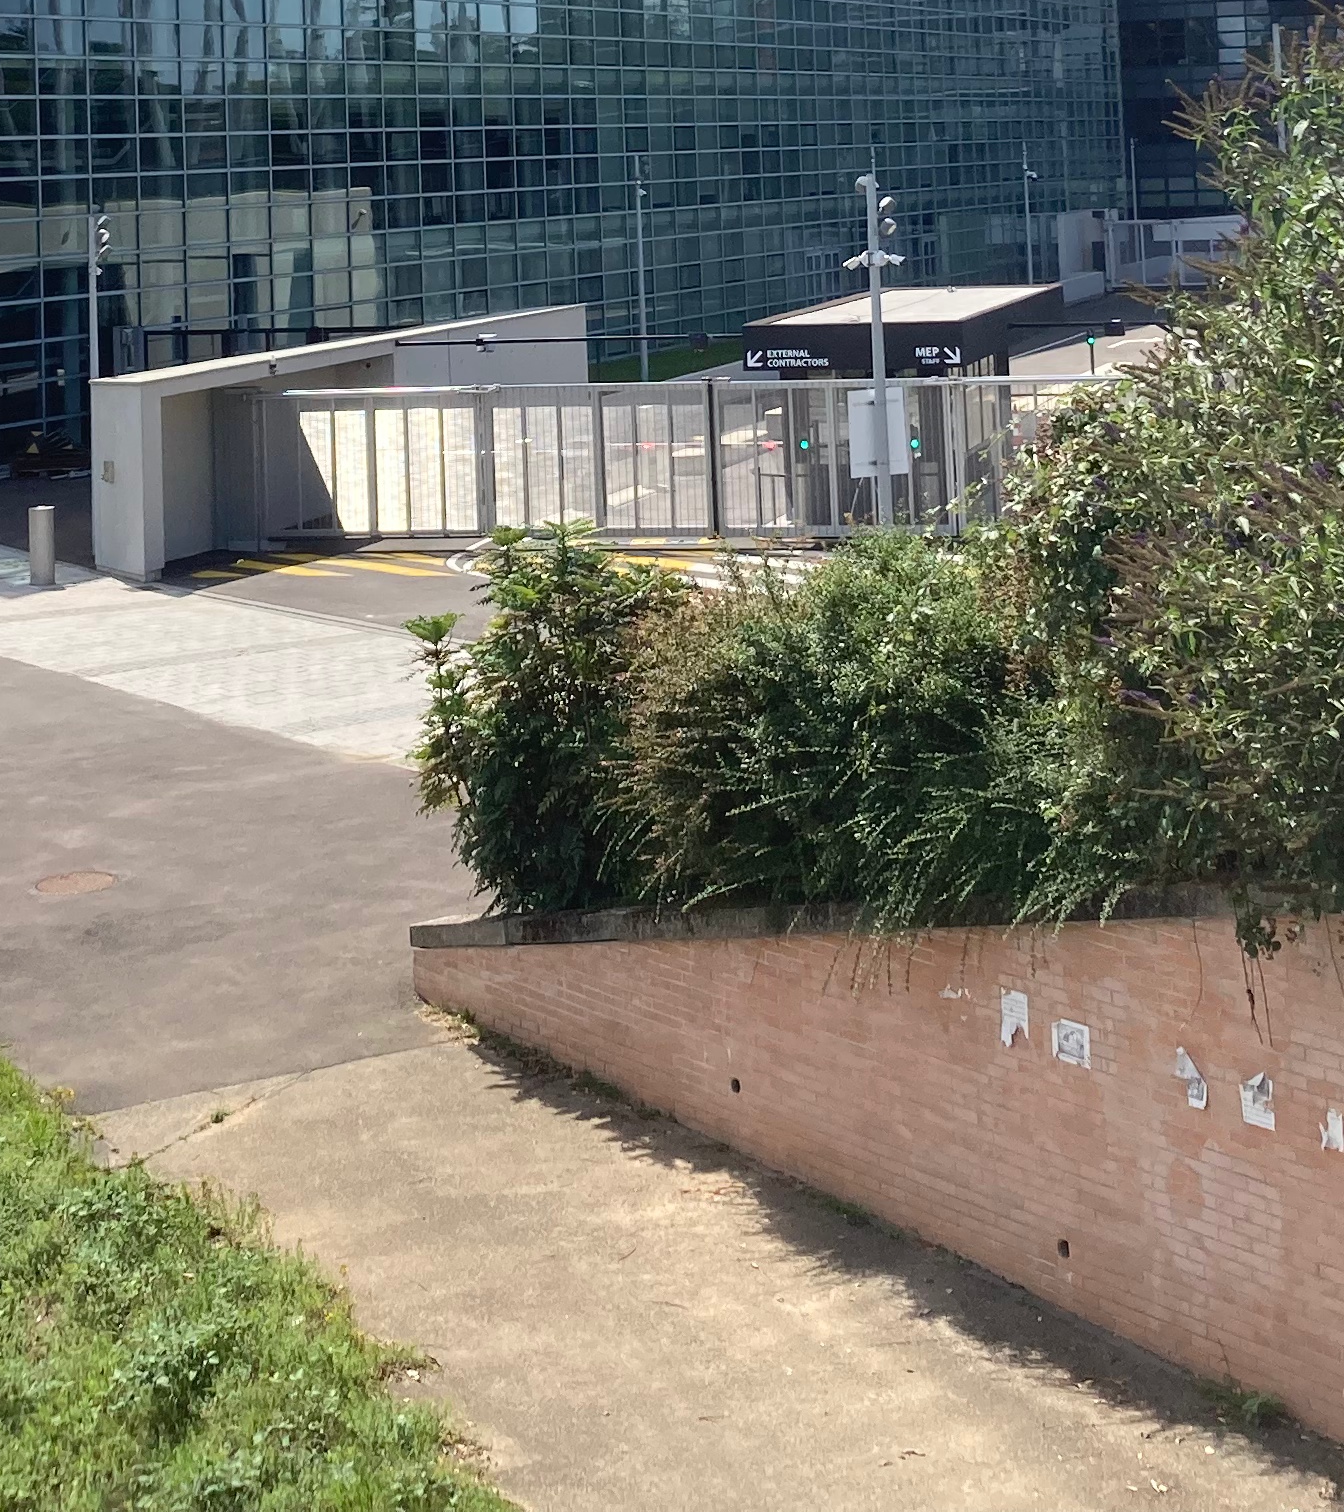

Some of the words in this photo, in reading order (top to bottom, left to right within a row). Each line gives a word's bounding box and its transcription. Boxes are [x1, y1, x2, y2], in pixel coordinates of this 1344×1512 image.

[767, 349, 810, 358] EXTERNAL
[915, 346, 940, 358] MEP
[767, 358, 829, 367] CONTRACTORS
